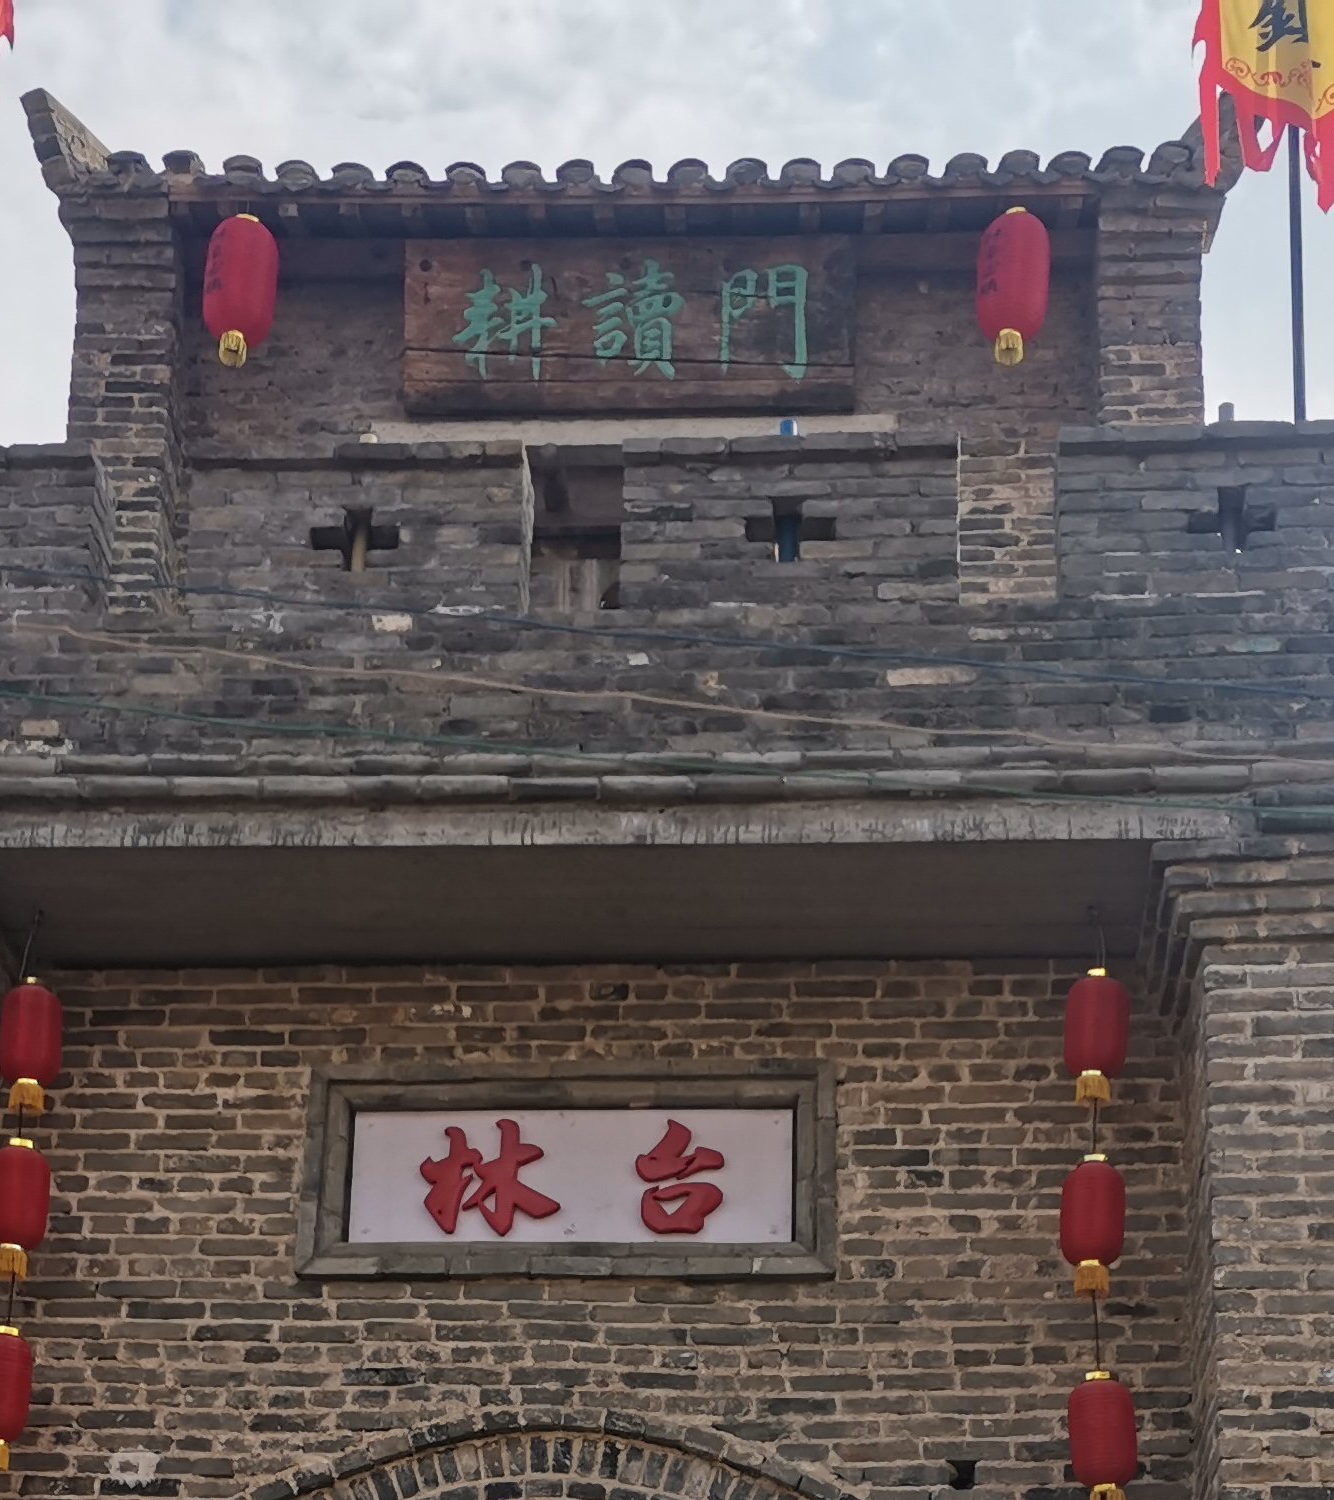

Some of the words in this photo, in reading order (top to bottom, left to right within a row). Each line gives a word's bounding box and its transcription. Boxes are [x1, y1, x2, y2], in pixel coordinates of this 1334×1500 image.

[452, 259, 808, 385] 耕讀門
[420, 1119, 725, 1237] 林台
